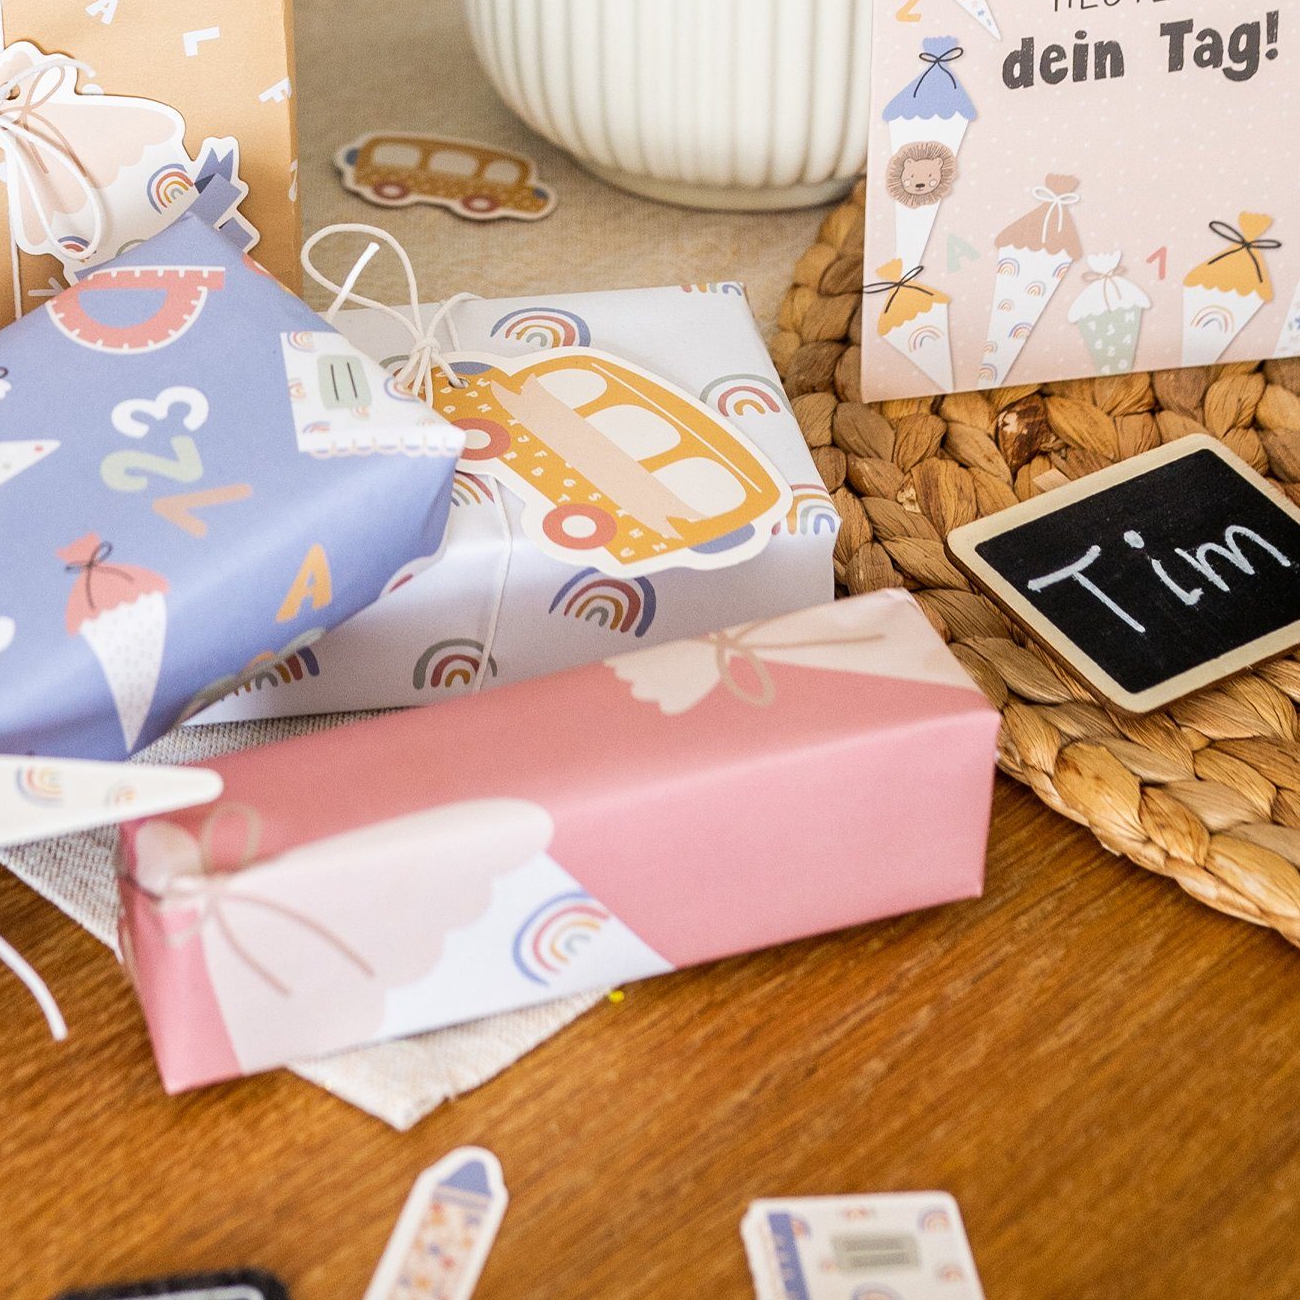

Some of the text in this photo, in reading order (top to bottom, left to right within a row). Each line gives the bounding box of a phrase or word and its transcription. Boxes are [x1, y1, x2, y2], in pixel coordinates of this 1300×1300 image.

[182, 26, 220, 57] L
[1002, 10, 1280, 90] dein Tag!
[945, 232, 981, 274] A
[1145, 245, 1168, 280] 1
[274, 543, 332, 623] A
[1027, 525, 1292, 634] Tim
